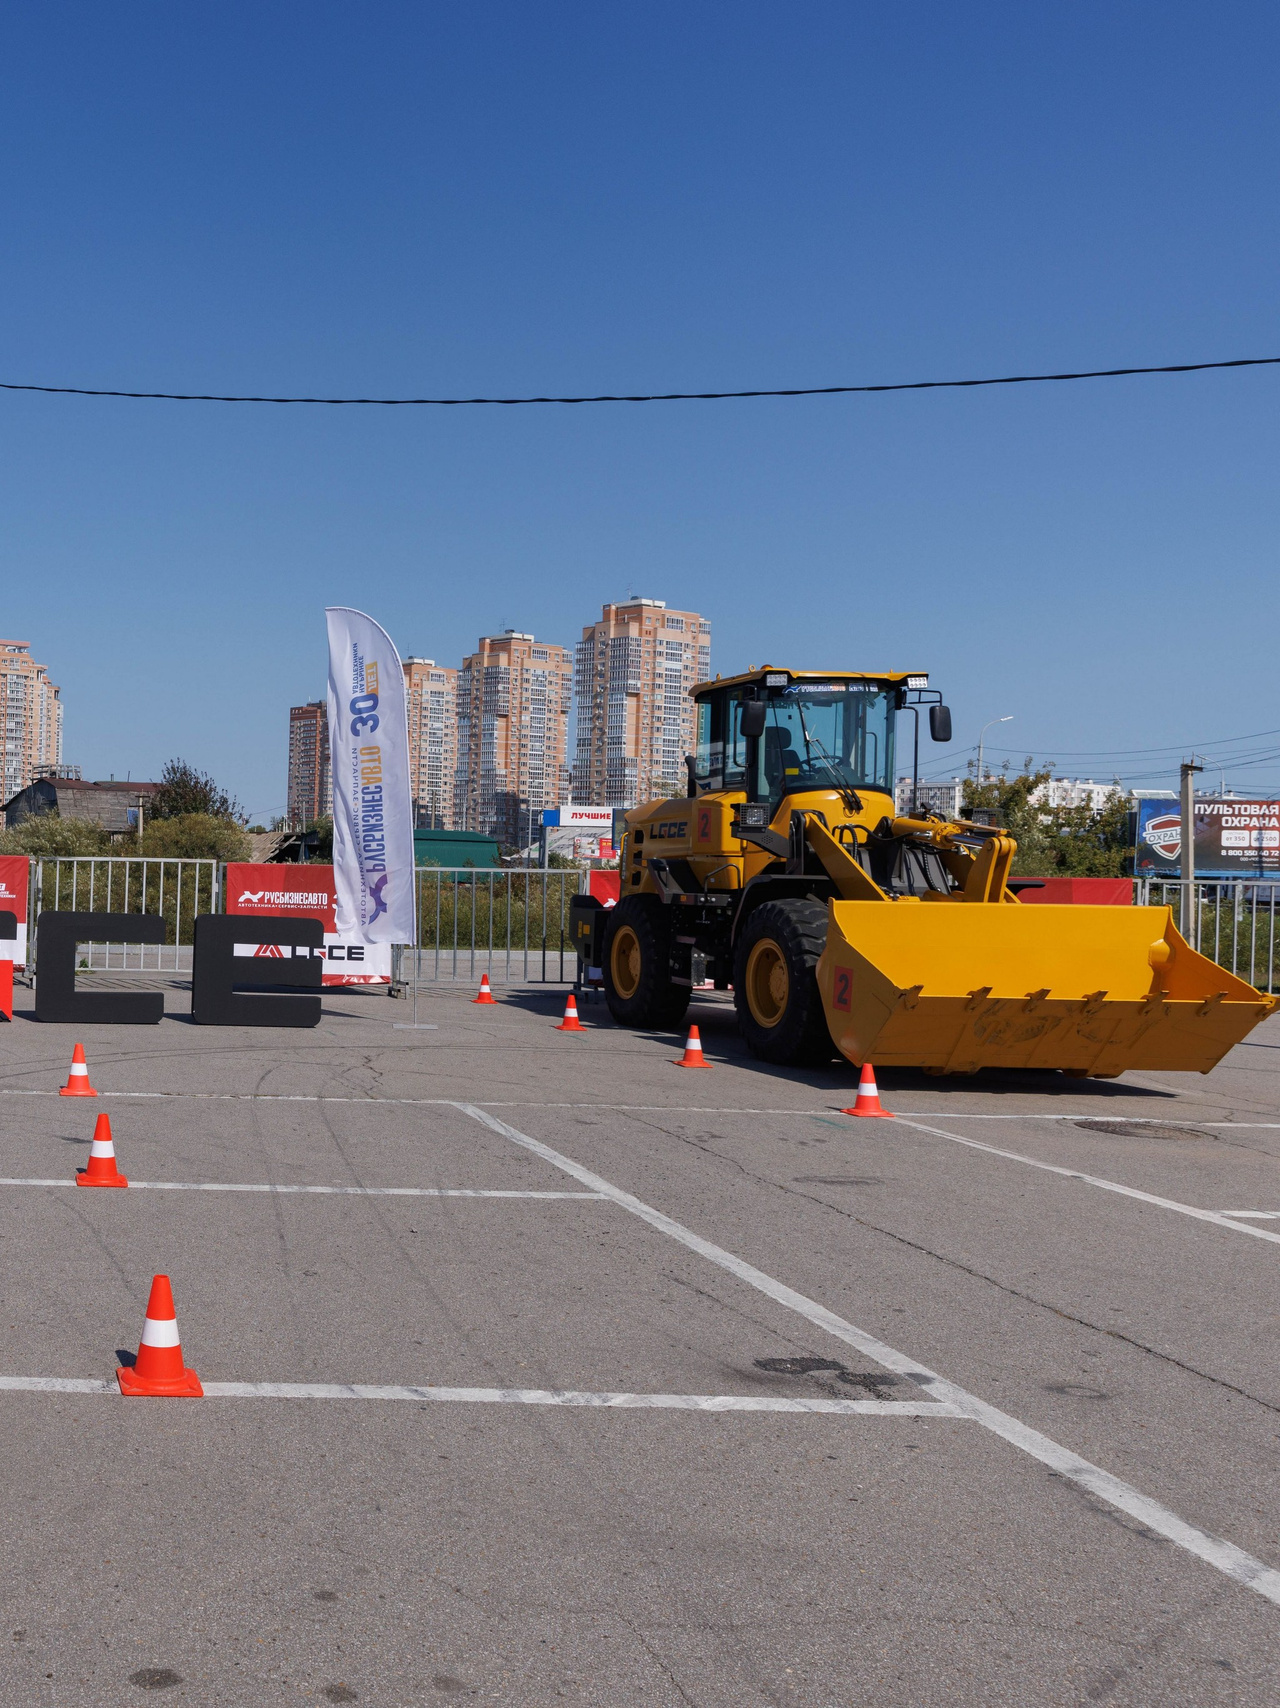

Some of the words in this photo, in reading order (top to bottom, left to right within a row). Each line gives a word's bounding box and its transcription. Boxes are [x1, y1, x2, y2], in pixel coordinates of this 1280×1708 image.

[571, 812, 612, 820] ЛУЧШИЕ
[1194, 804, 1279, 815] ПУЛЬТОВАЯ
[701, 813, 709, 838] 2
[1221, 816, 1280, 827] ОХРАНА
[1149, 829, 1181, 842] ОХРАН
[264, 891, 328, 905] РУСБИЗНЕСАВТО
[837, 973, 849, 1006] 2
